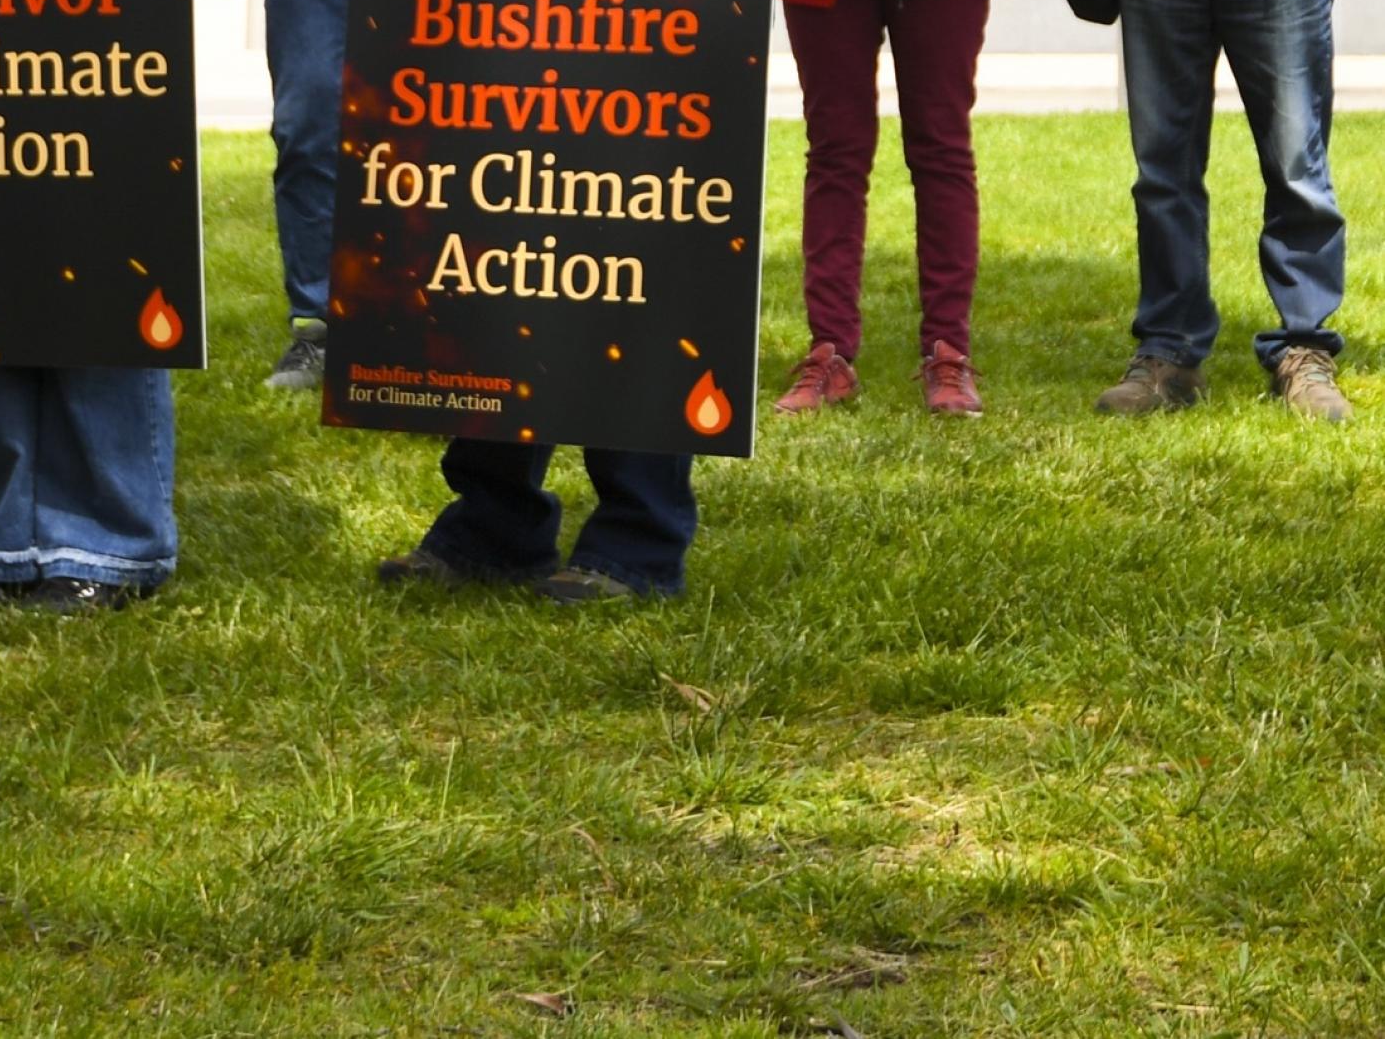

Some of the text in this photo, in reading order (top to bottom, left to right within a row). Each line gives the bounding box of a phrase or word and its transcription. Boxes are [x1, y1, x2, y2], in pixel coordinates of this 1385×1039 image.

[389, 68, 712, 139] Survivors
[361, 143, 732, 223] for Climate
[426, 234, 646, 303] Action
[349, 384, 502, 412] for Climate Action
[351, 364, 512, 392] Bushfire Survivors
